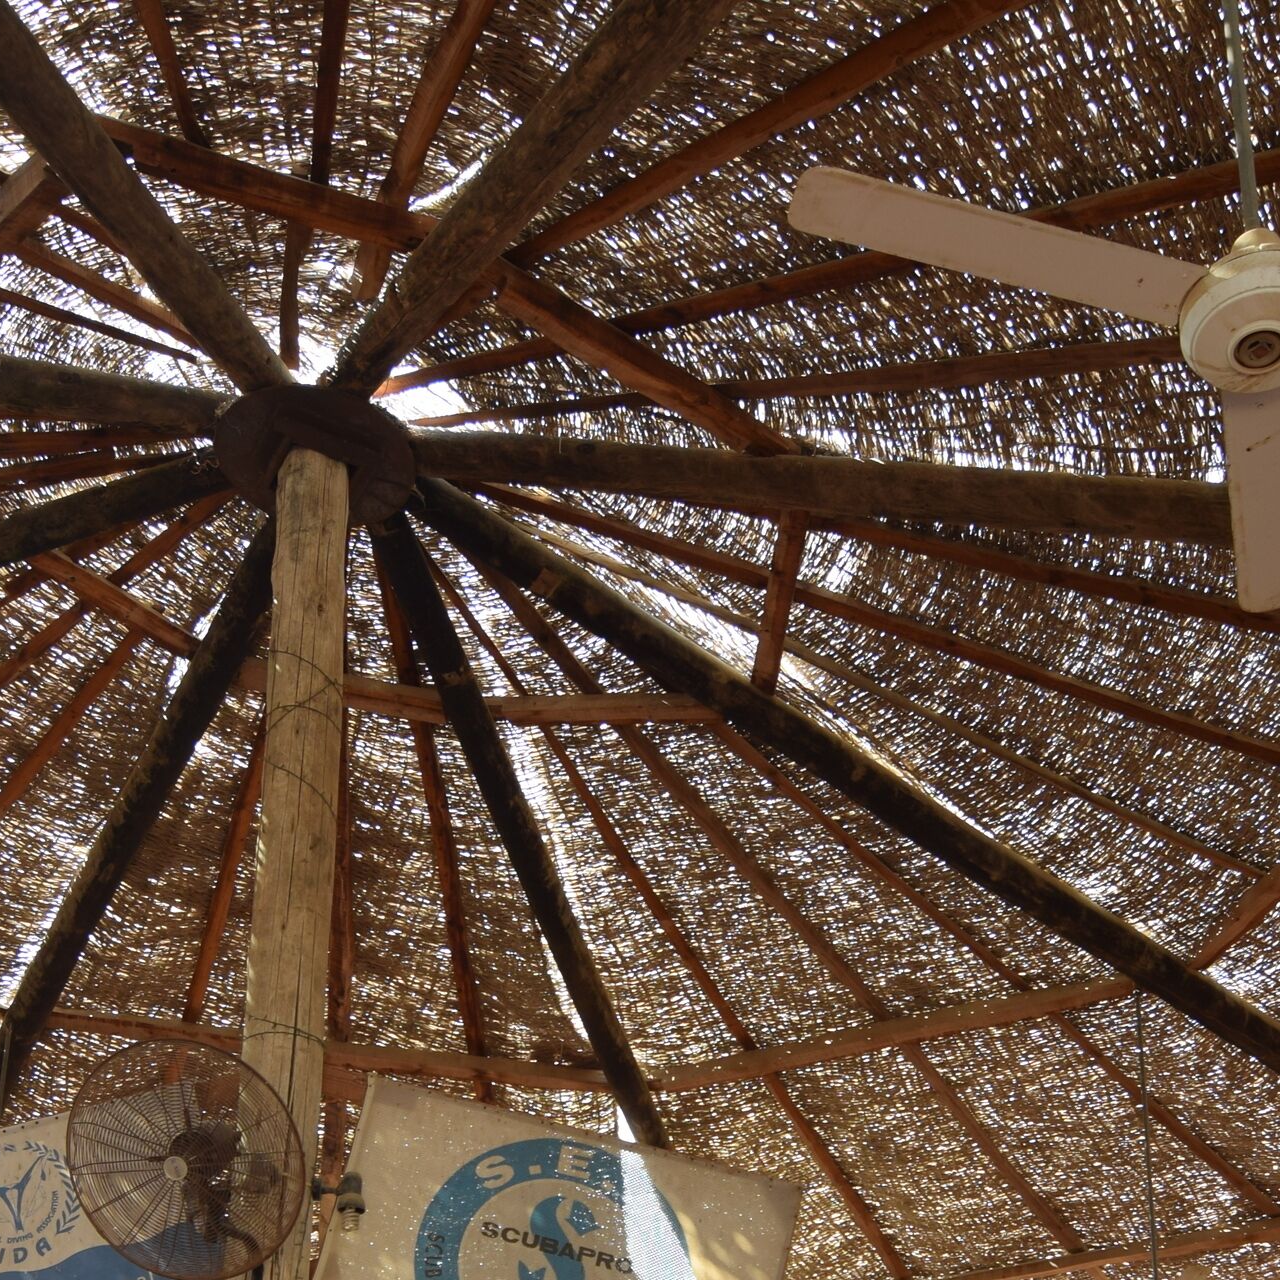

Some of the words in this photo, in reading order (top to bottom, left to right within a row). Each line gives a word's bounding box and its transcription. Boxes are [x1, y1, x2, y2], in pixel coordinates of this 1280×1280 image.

[7, 1232, 33, 1244] DIVING
[36, 1190, 59, 1233] ASSOCIATION
[480, 1221, 633, 1274] SCUBAPRO
